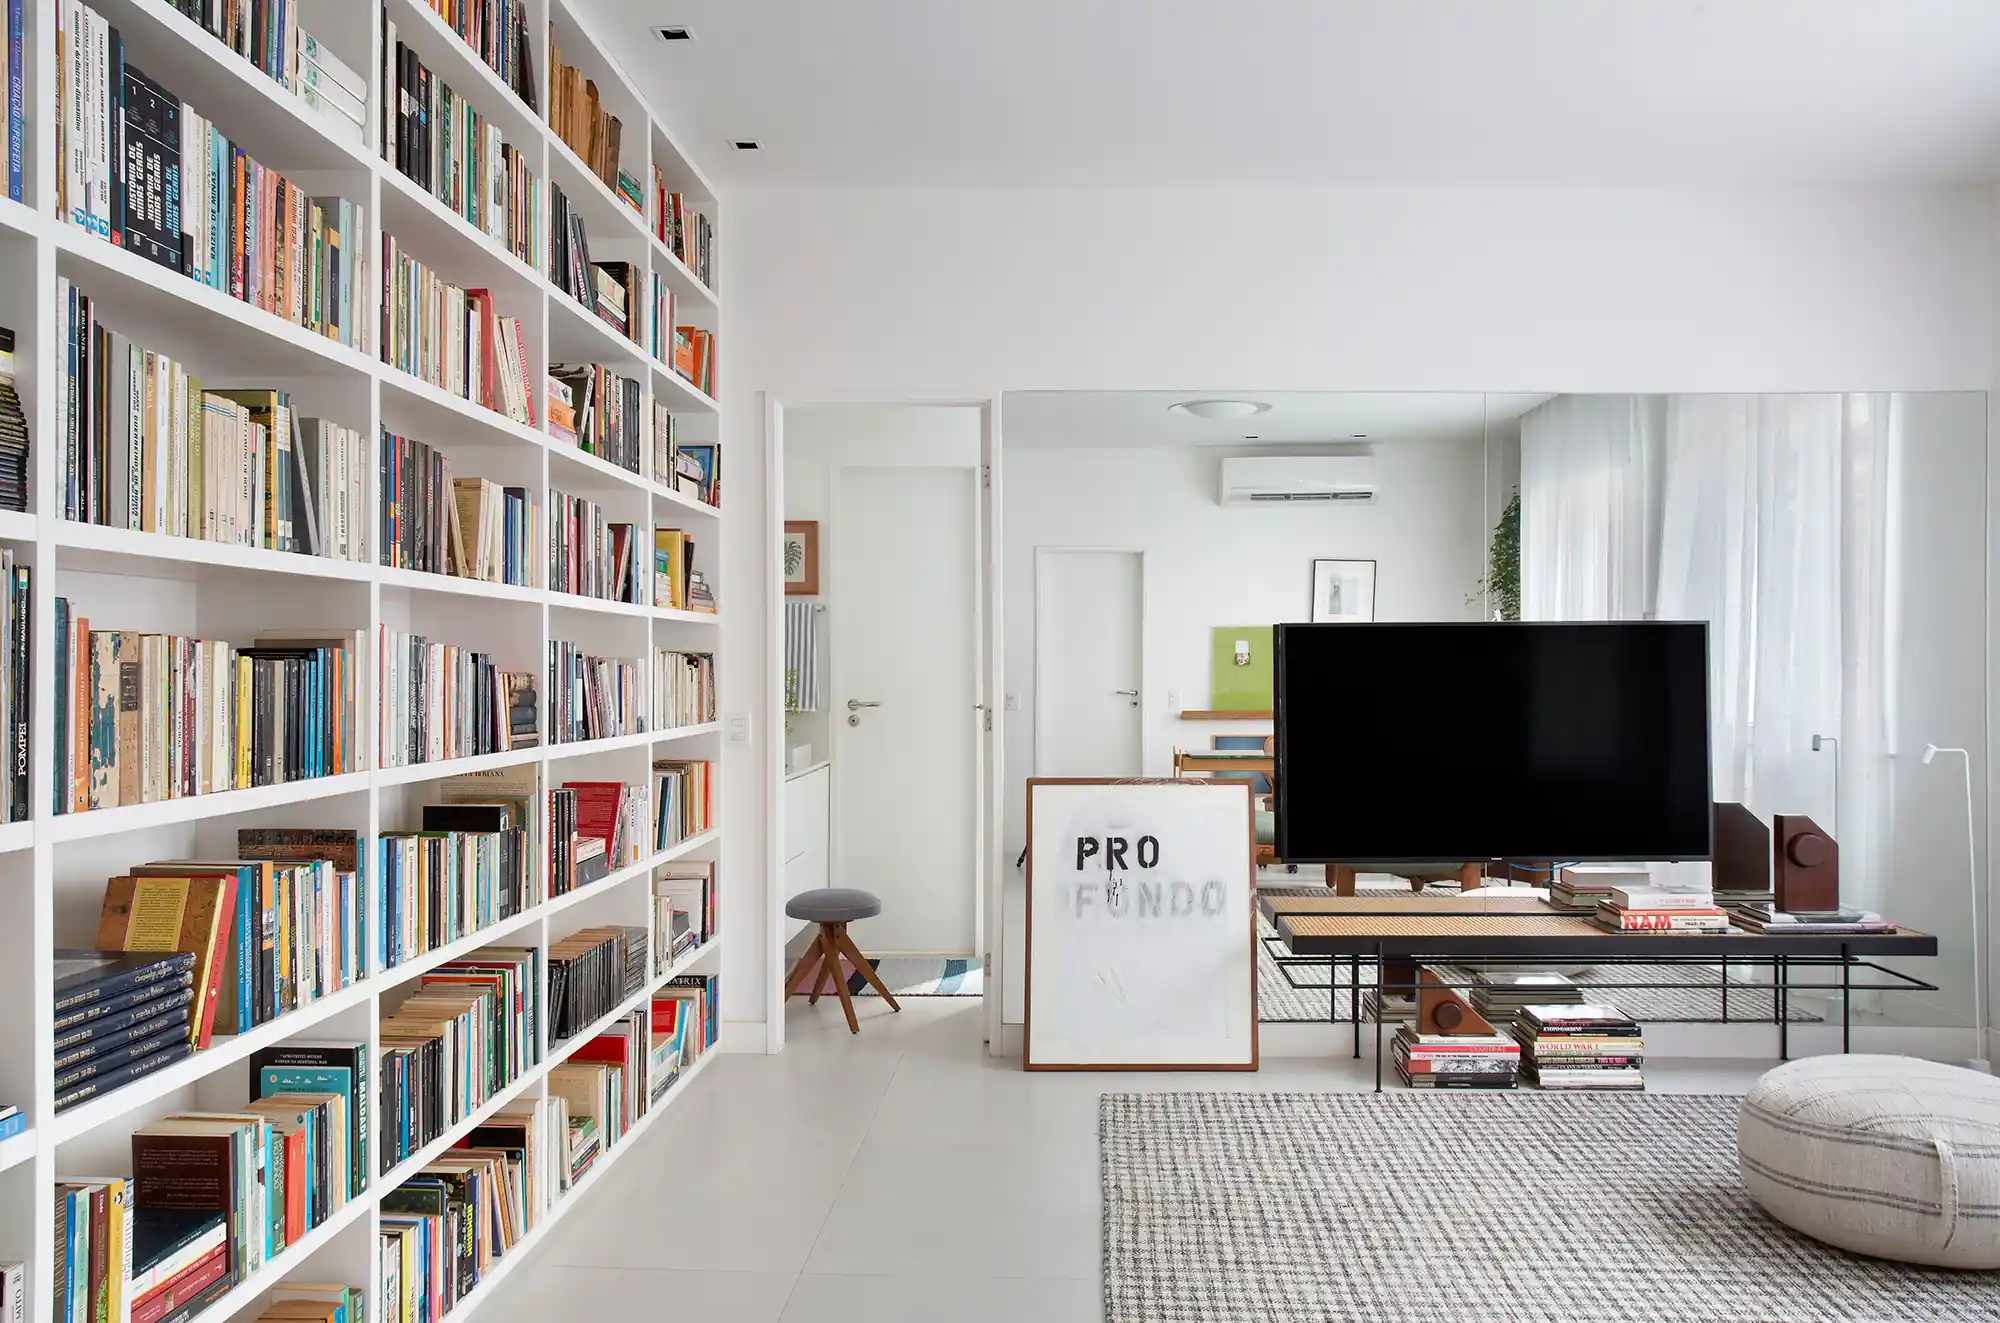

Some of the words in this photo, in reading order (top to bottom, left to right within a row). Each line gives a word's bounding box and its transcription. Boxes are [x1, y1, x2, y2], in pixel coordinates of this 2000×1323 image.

[75, 50, 81, 59] do
[13, 76, 21, 117] CRIAÇÃO
[132, 86, 136, 95] 1
[150, 99, 155, 108] 2
[169, 110, 174, 119] 3
[13, 118, 21, 172] IMPERFEITA
[128, 144, 136, 159] DE
[136, 140, 144, 181] GERAIS
[146, 156, 154, 171] DE
[128, 160, 136, 211] HISTÓRIA
[165, 166, 172, 183] DE
[136, 184, 144, 221] MINAS
[146, 171, 155, 221] HISTÓRIA
[154, 193, 162, 231] MINAS
[164, 184, 172, 229] HISTÓRIA
[211, 208, 216, 222] DE
[576, 262, 588, 301] SANGUE
[518, 344, 532, 398] HIROSHIMA
[18, 722, 26, 776] POMPEI
[1076, 835, 1160, 871] PRO
[1624, 916, 1672, 929] NAM
[122, 1220, 133, 1281] Mitologia
